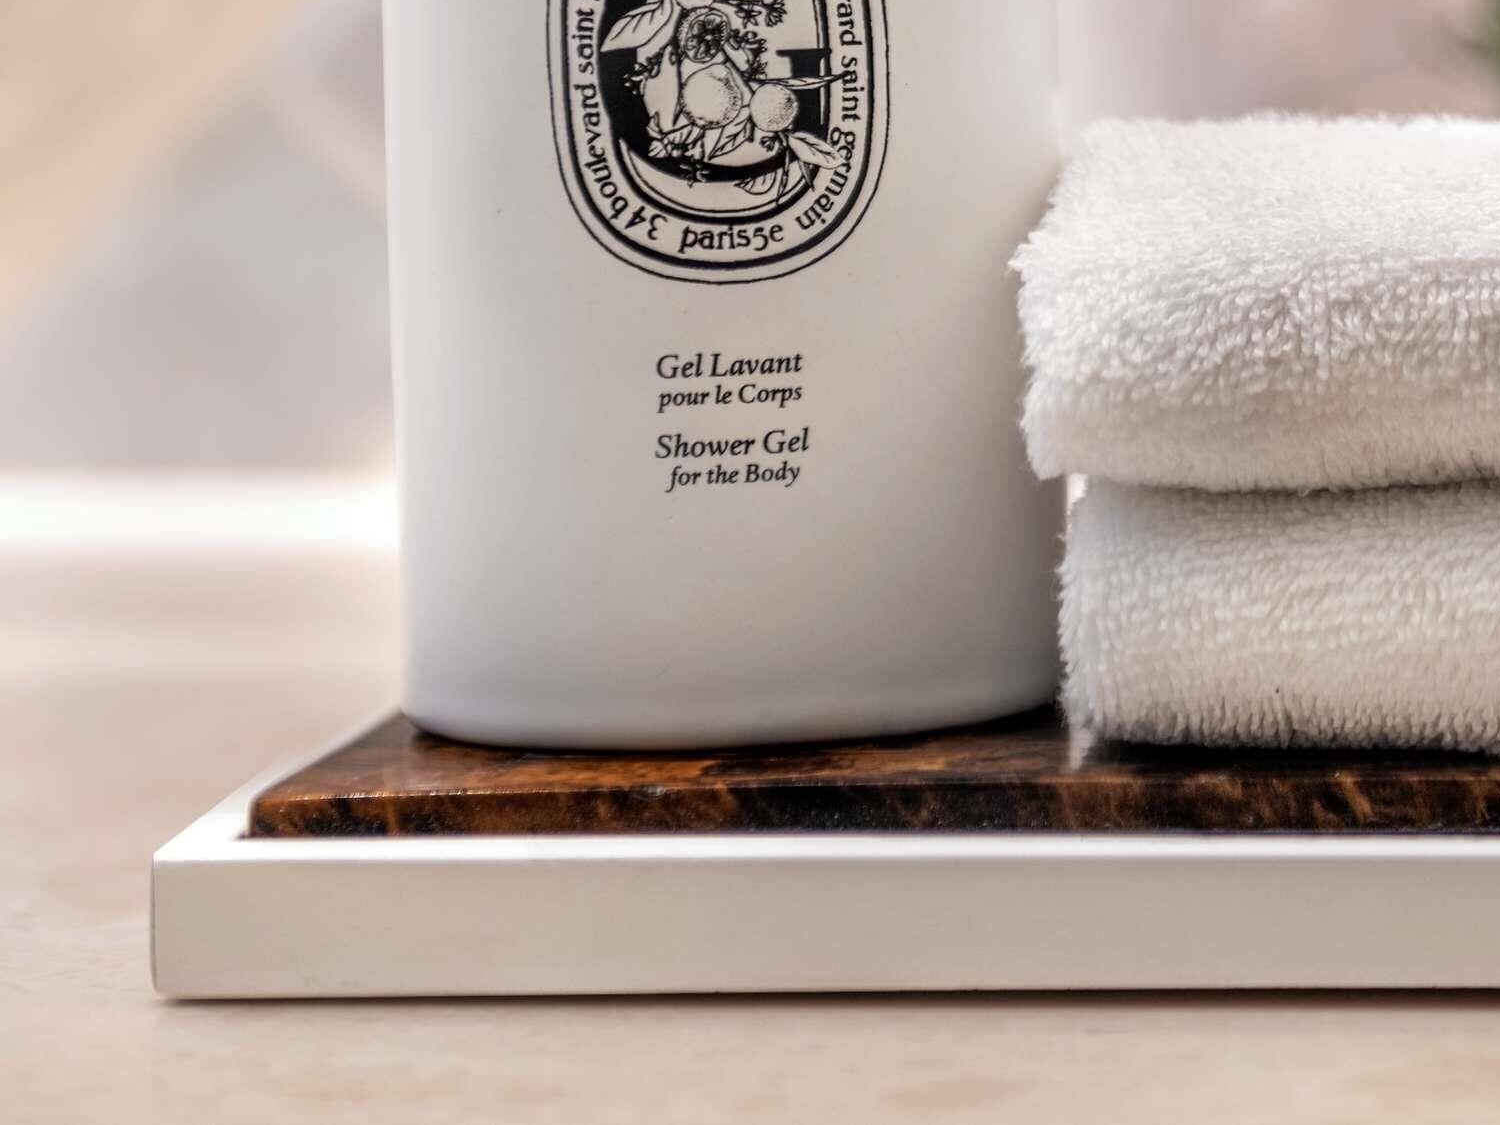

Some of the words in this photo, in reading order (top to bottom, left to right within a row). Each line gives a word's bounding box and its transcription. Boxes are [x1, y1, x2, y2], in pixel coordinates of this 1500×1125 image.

[571, 7, 595, 75] saint
[841, 55, 865, 122] saint
[795, 127, 856, 231] germain
[656, 352, 703, 379] Gel
[709, 352, 803, 378] Lavant
[656, 389, 710, 414] pour
[714, 384, 732, 405] le
[738, 383, 803, 409] Corps
[655, 432, 756, 459] Shower
[762, 426, 810, 455] Gel
[664, 465, 701, 493] for
[706, 464, 739, 485] the
[744, 460, 800, 488] Body
